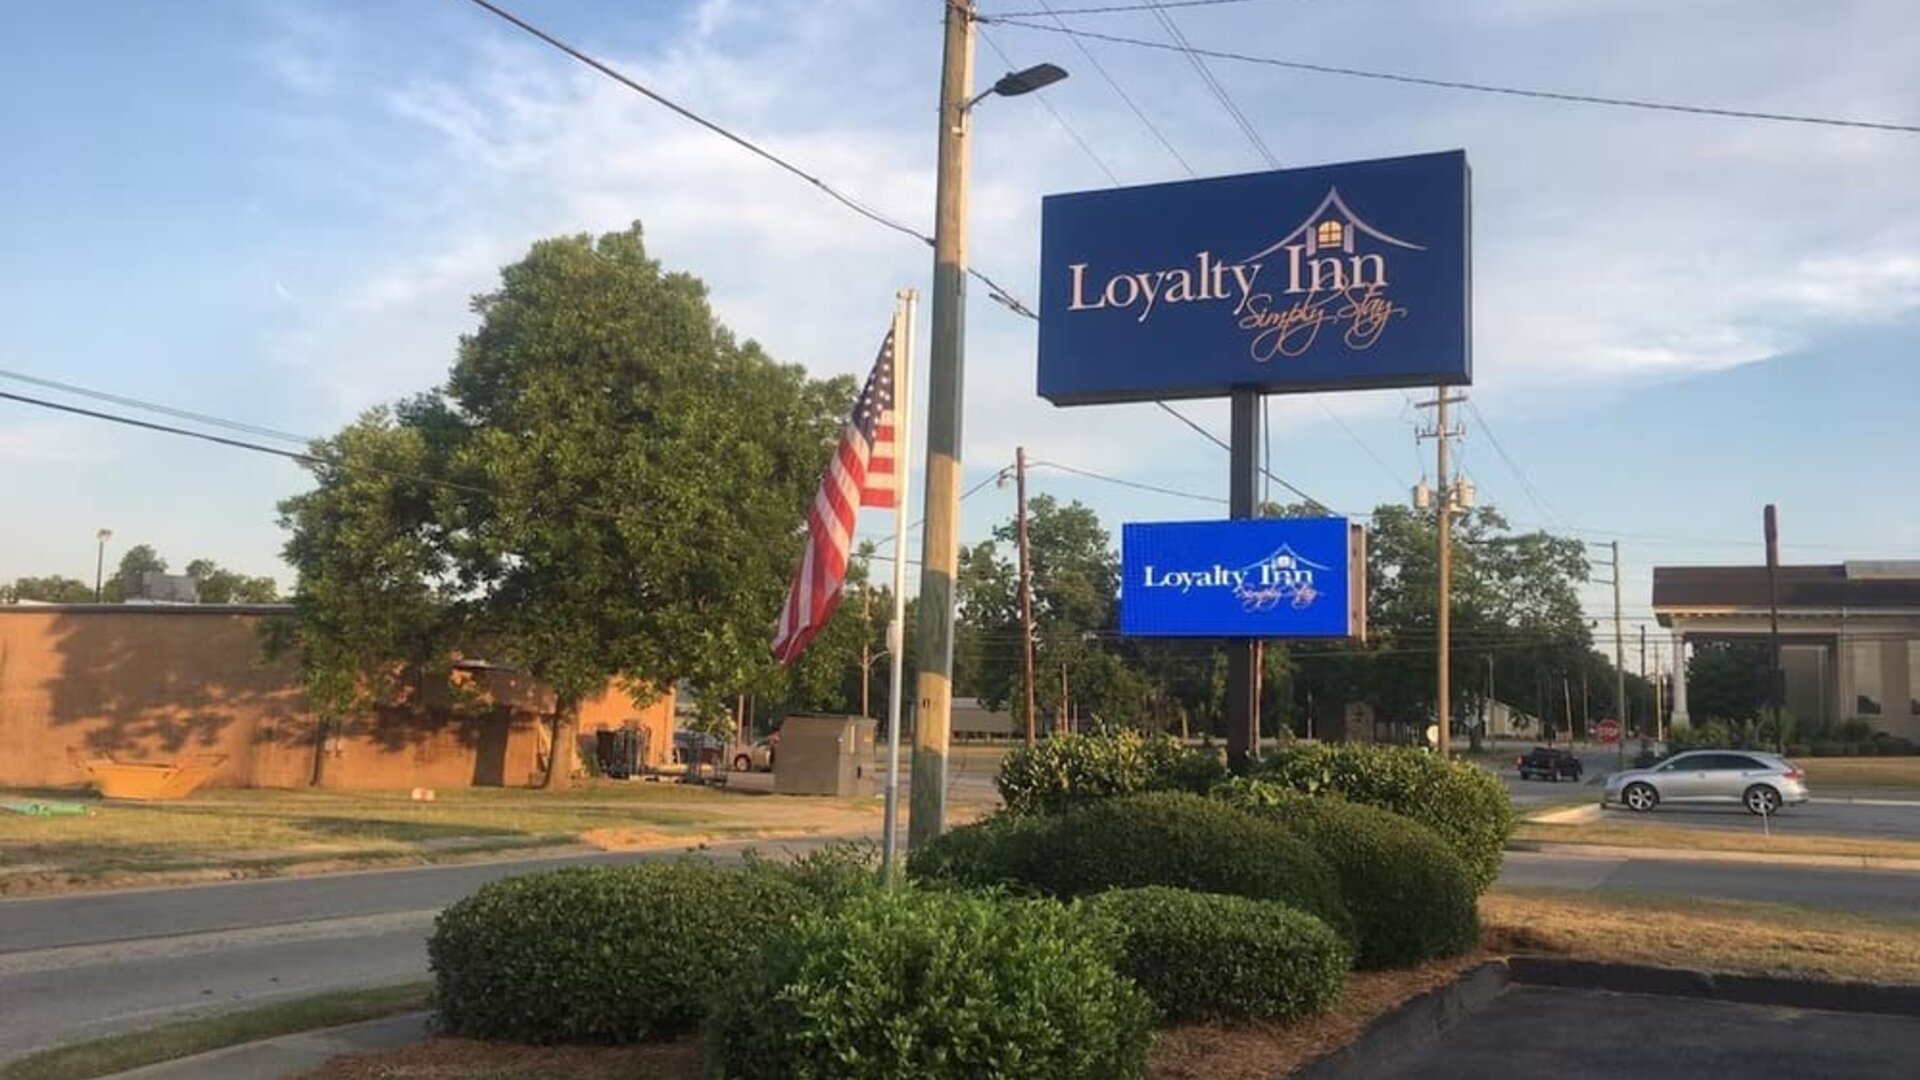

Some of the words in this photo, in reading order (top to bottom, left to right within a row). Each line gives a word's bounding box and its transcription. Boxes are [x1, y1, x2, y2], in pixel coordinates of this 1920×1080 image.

[1068, 250, 1263, 322] Loyalty
[1284, 243, 1388, 293] Inn
[1238, 272, 1344, 362] Simply
[1337, 282, 1408, 350] Stay
[1144, 564, 1248, 594] Loyalty
[1261, 563, 1313, 585] Inn
